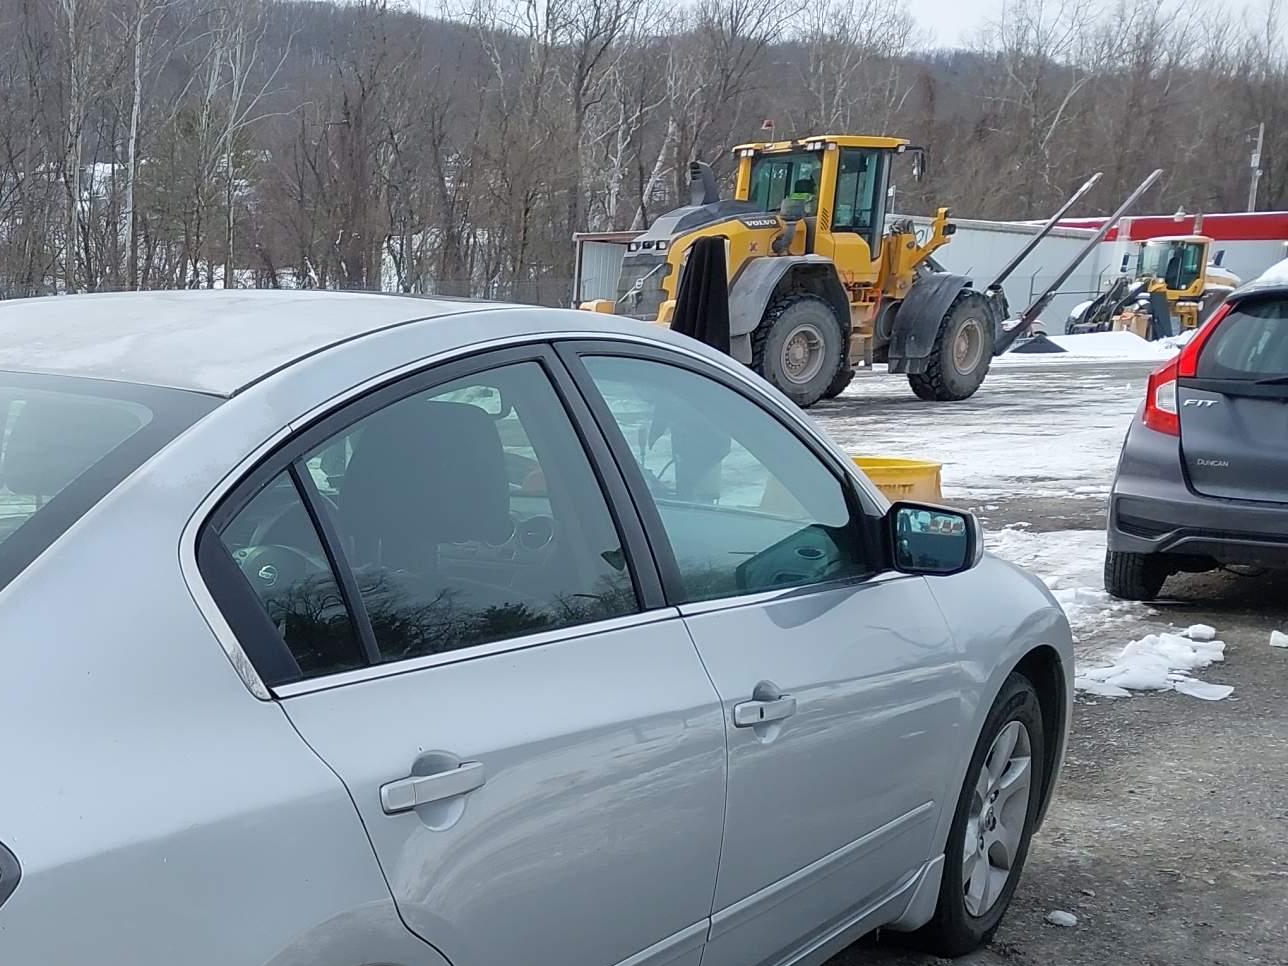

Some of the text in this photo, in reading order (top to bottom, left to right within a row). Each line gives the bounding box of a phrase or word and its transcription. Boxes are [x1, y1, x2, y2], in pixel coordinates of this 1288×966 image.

[744, 219, 777, 227] VOLVO
[1183, 399, 1220, 408] FIT
[1196, 458, 1230, 468] DUNCAN
